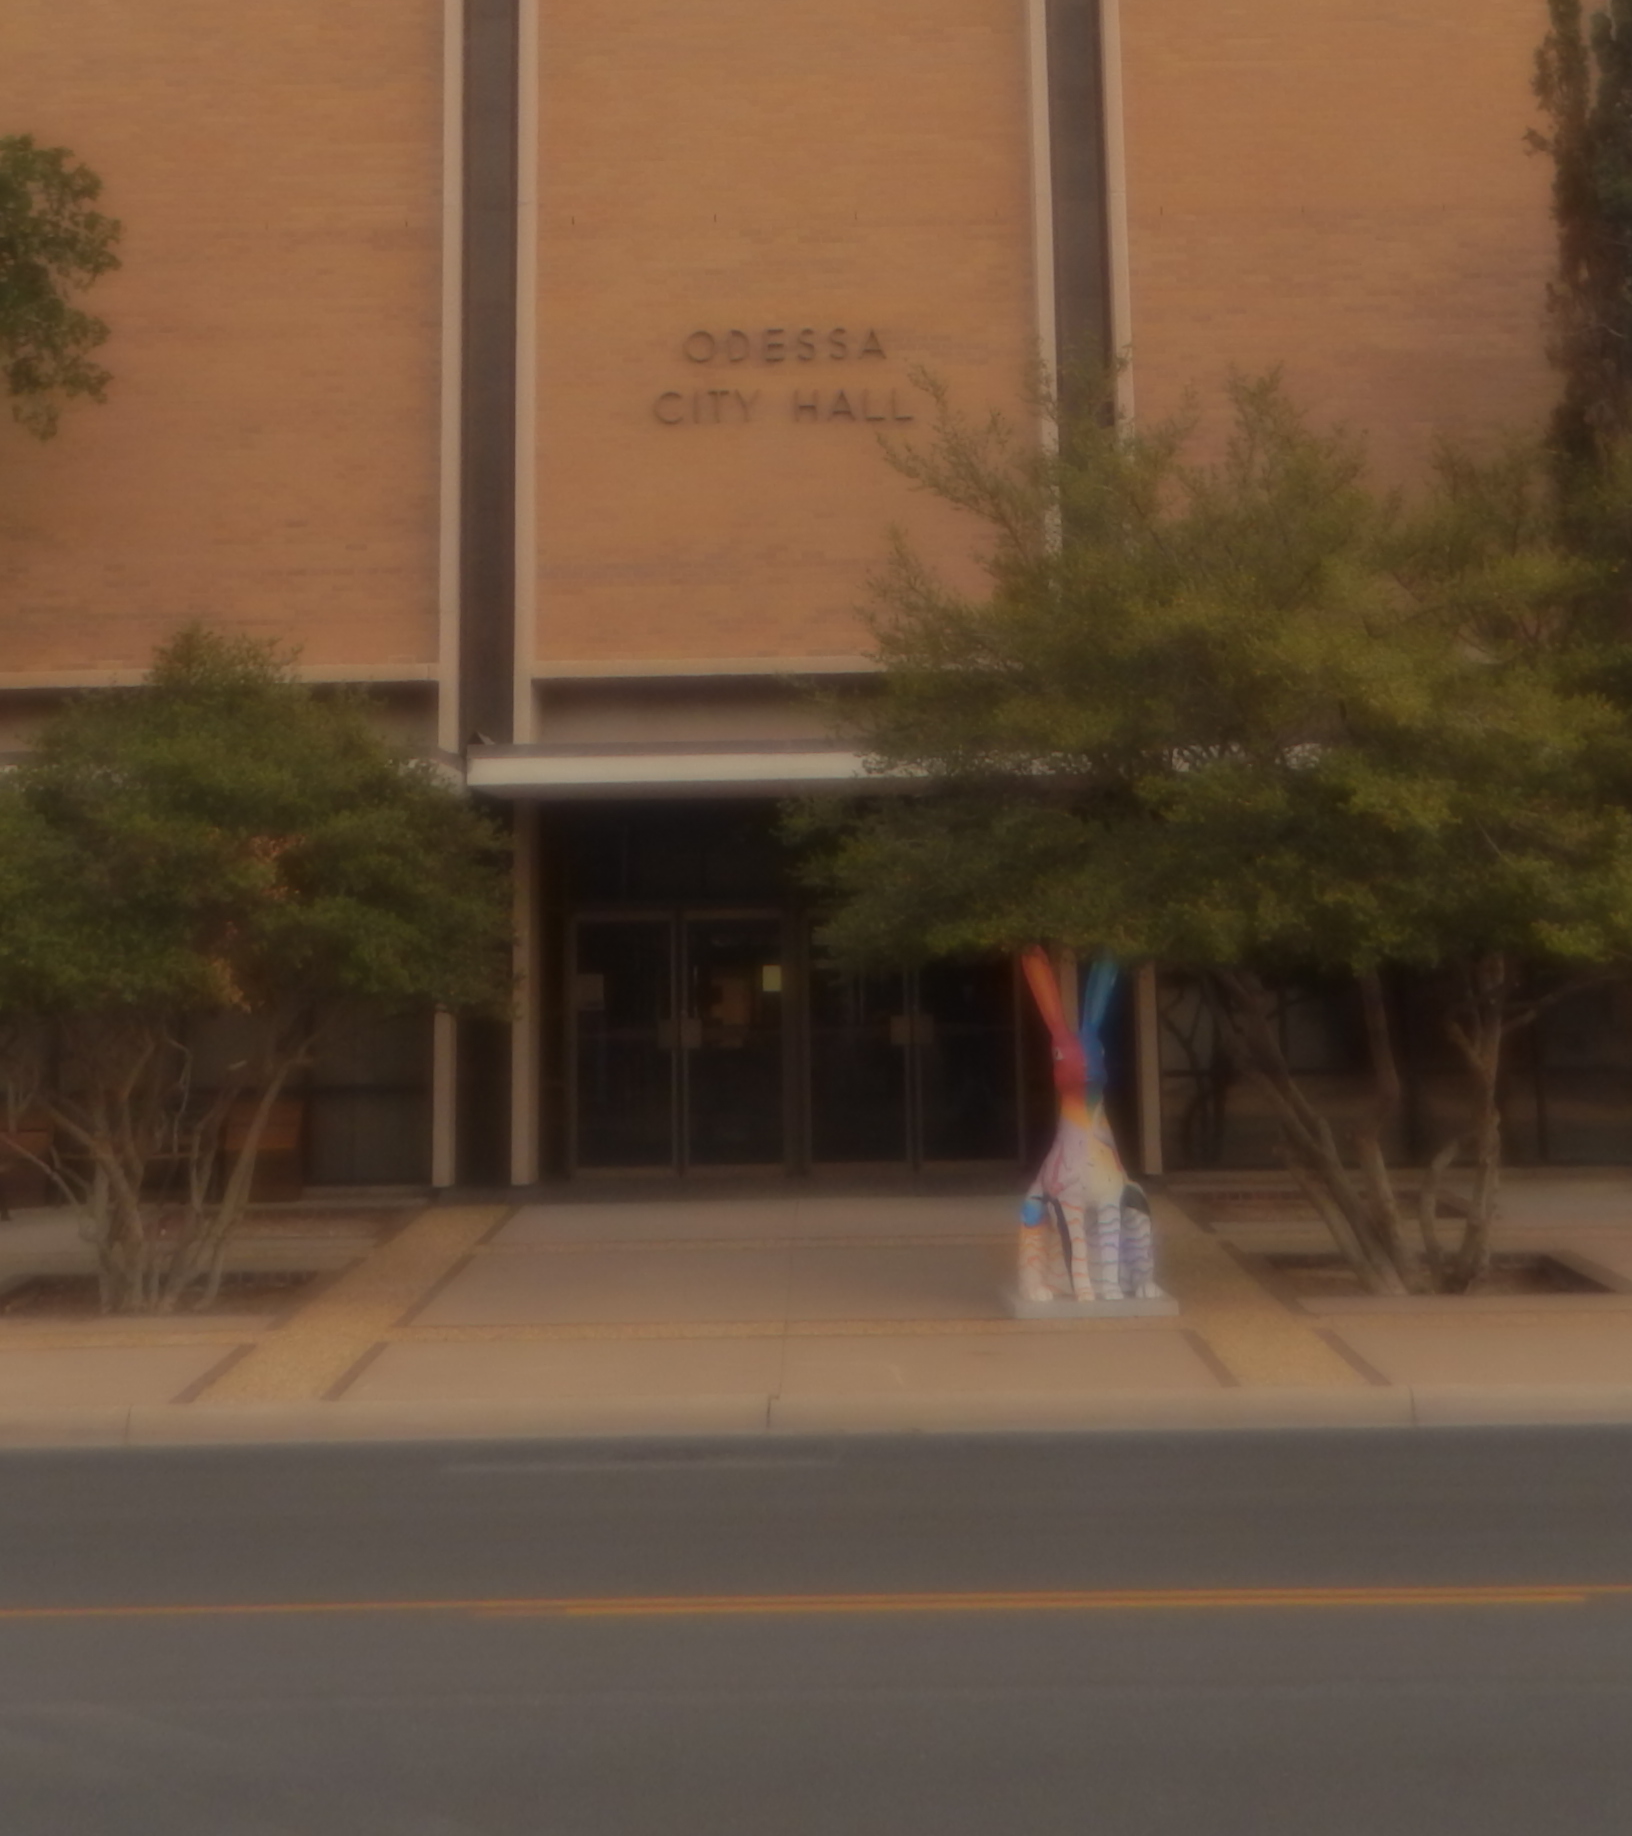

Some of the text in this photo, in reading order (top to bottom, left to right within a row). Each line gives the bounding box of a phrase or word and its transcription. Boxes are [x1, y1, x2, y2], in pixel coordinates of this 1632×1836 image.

[682, 327, 888, 365] ODESSA
[652, 387, 915, 426] CITY HALL
